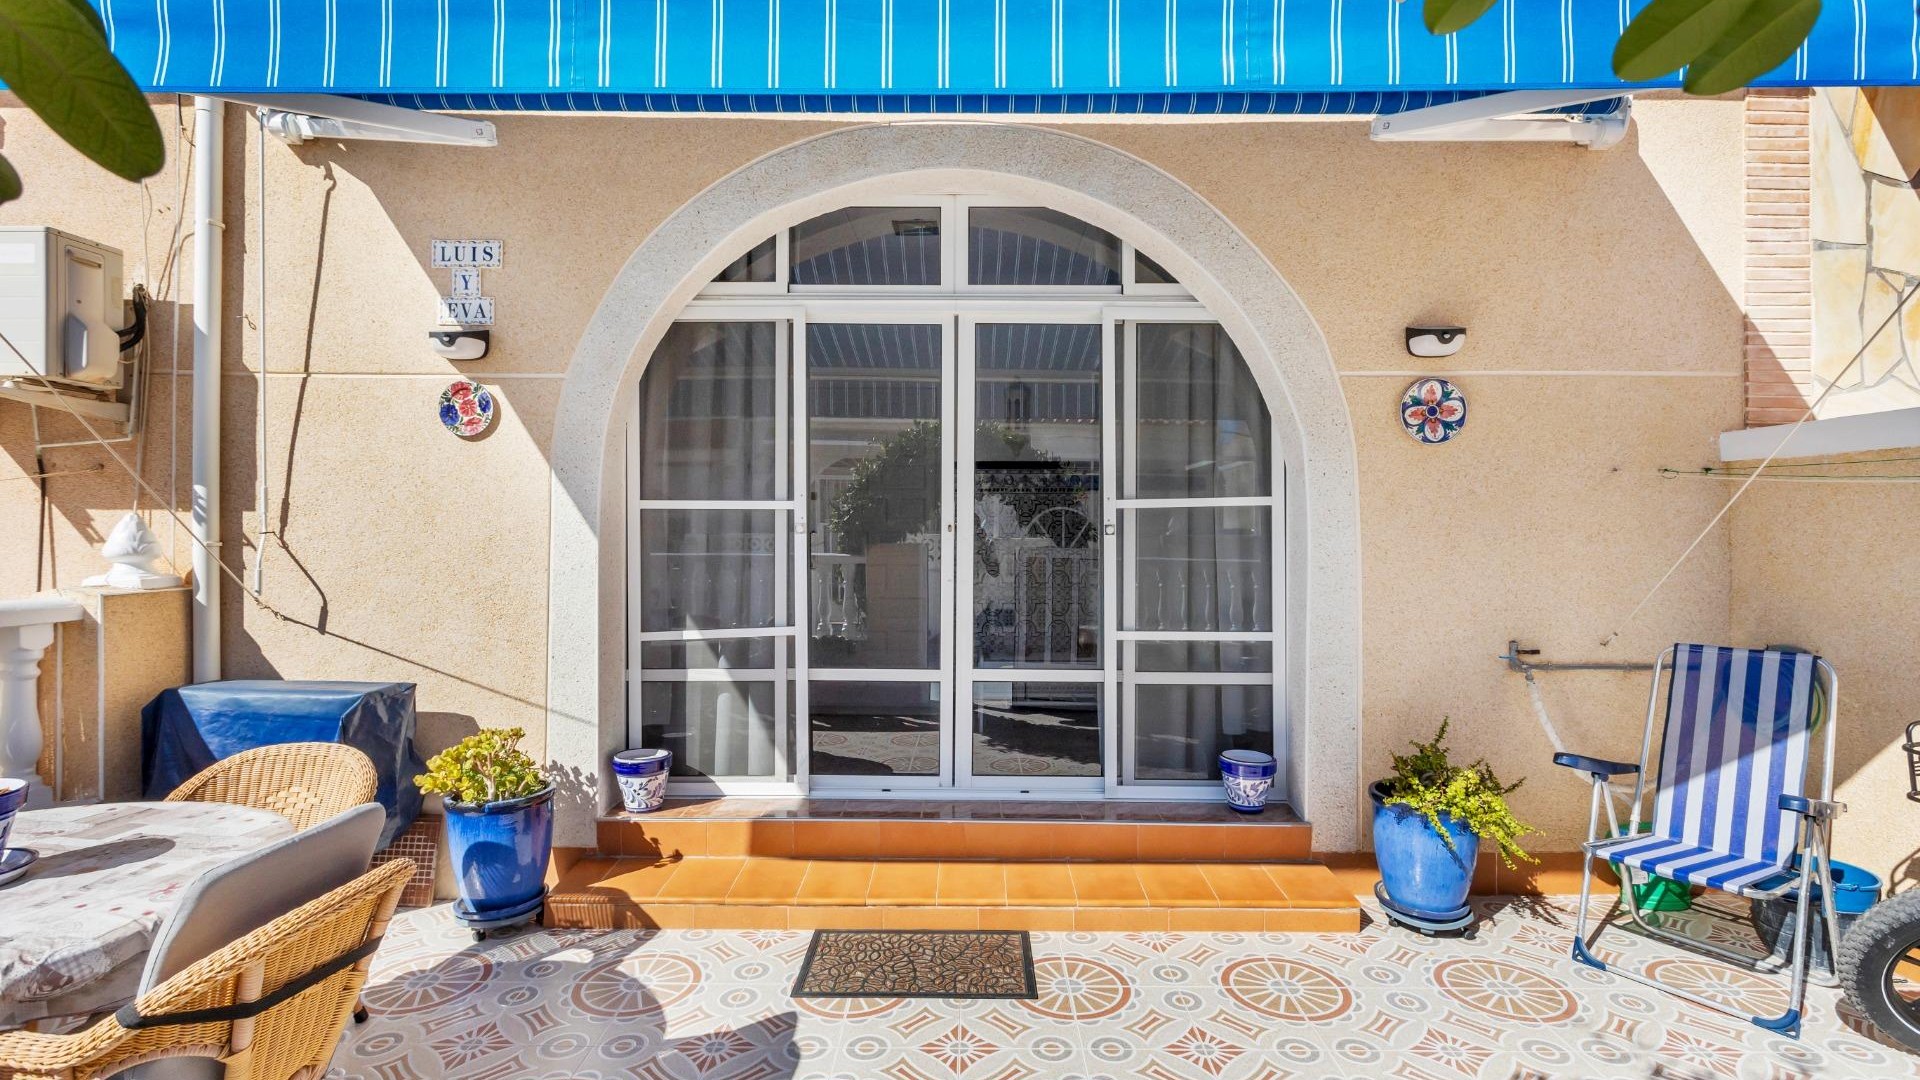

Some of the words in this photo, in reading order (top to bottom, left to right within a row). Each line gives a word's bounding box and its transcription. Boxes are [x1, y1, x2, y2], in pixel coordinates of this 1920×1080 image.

[440, 246, 494, 262] LUIS
[461, 274, 472, 290] Y
[447, 302, 487, 319] EVA
